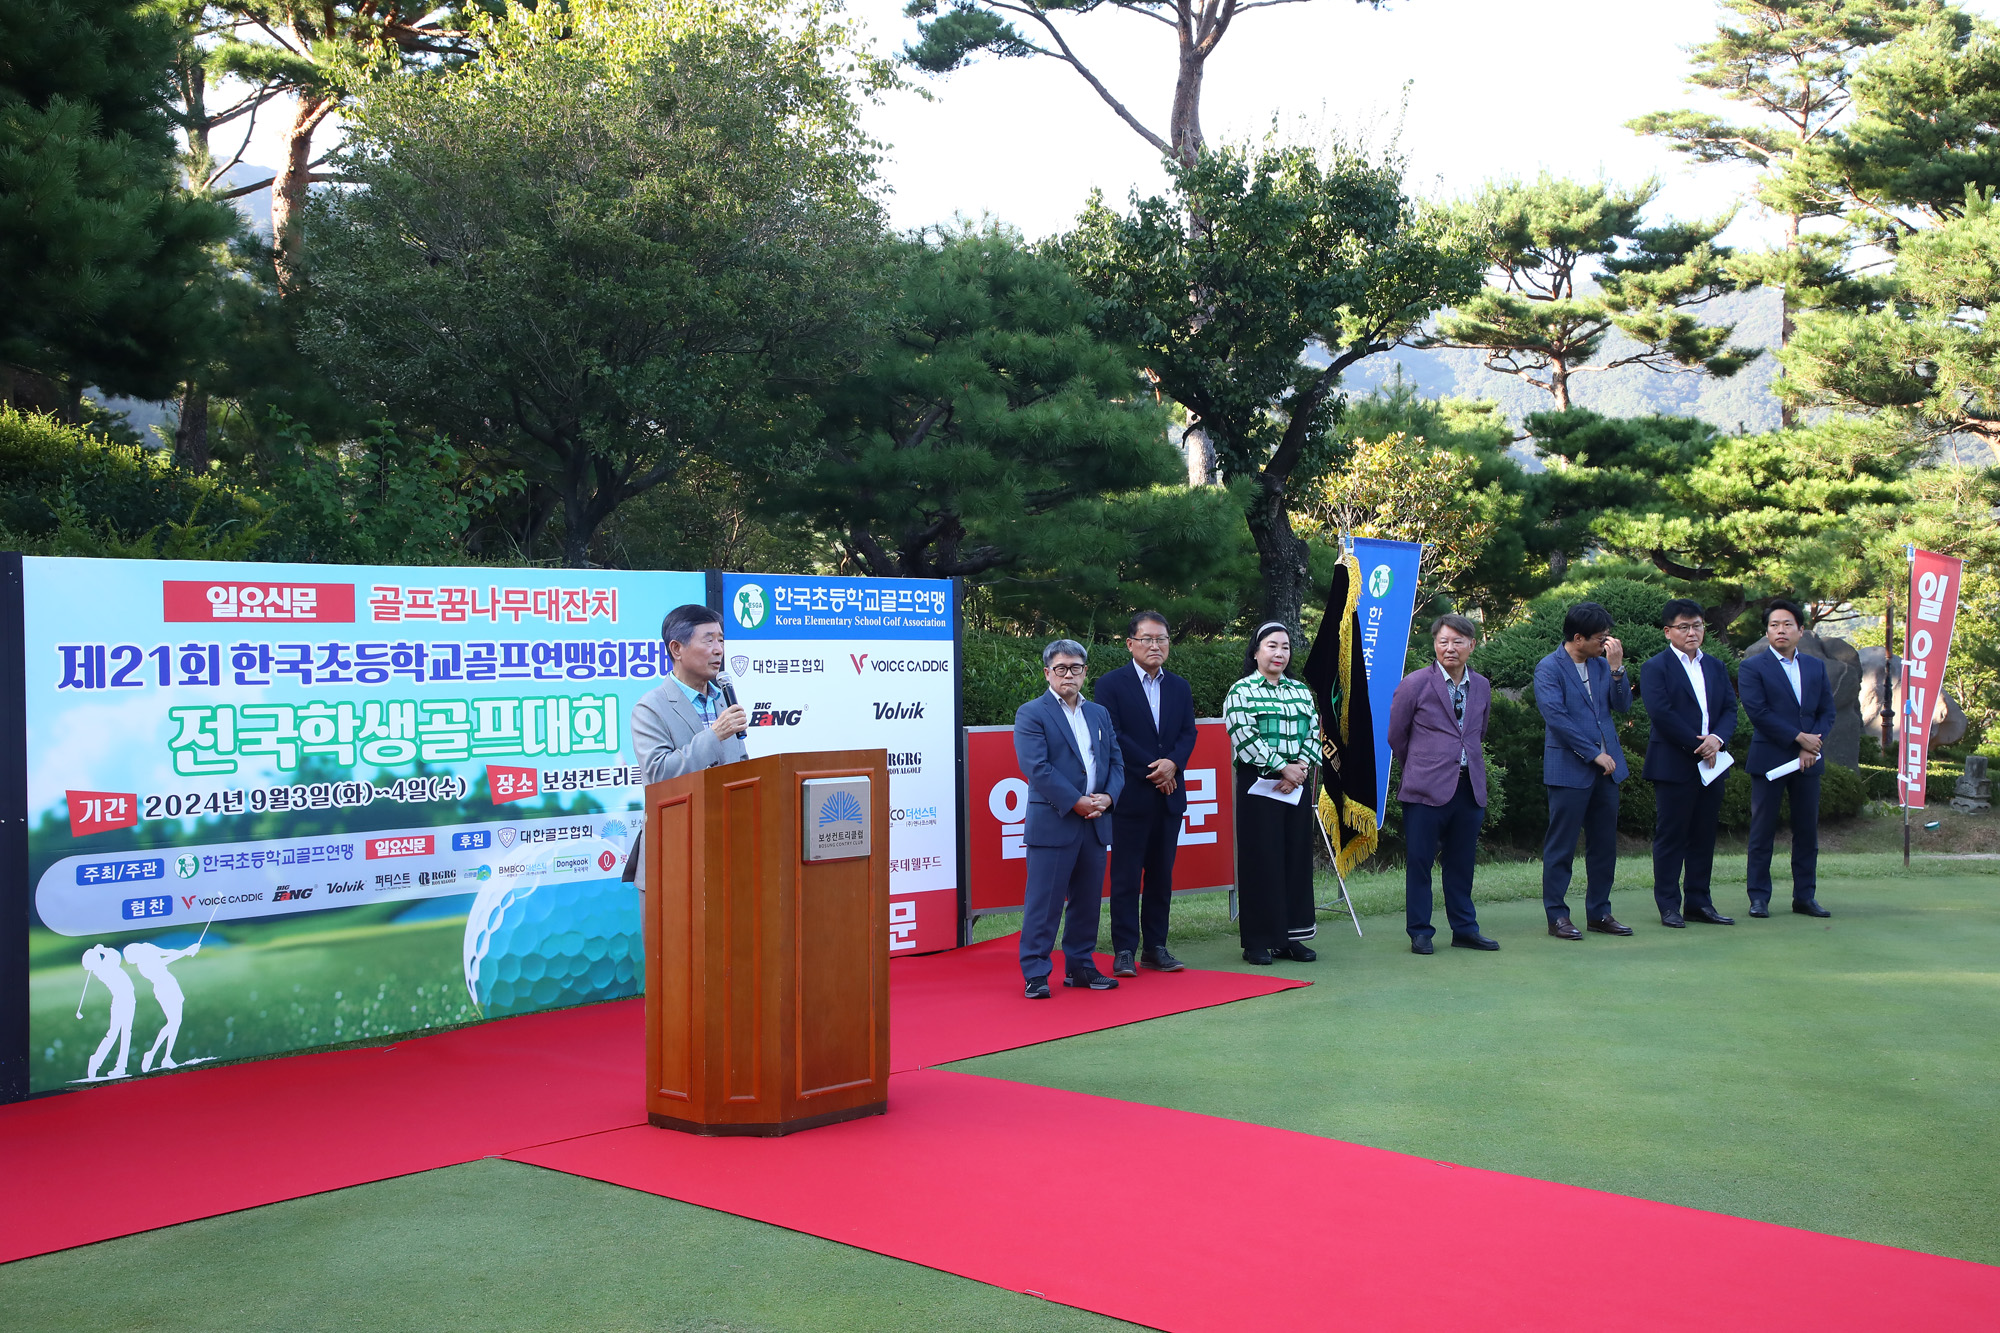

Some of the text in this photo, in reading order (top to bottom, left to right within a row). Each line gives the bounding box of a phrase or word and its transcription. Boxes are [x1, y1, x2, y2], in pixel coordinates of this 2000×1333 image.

[206, 586, 317, 618] 일요신문
[369, 585, 618, 622] 골프꿈나무대잔치
[774, 586, 945, 614] 한국초등학교골프연맹
[775, 614, 946, 628] Korea Elementary School Golf Association
[1362, 606, 1383, 680] 한국초
[57, 643, 220, 689] 제21회
[753, 659, 824, 674] 대한골프협회
[870, 660, 949, 672] VOICE CADDIE
[1905, 571, 1949, 791] 일요신문
[753, 702, 772, 710] BIG
[872, 701, 925, 720] Volvik
[169, 694, 620, 778] 전국학생골프대회
[79, 798, 128, 823] 기간
[145, 790, 244, 818] 2024년
[496, 773, 534, 795] 장소
[906, 806, 937, 820] 더선스틱
[460, 832, 484, 849] 후원
[520, 825, 593, 843] 대한골프협회
[818, 830, 864, 842] 보성컨트리클럽
[374, 837, 426, 857] 일요신문
[202, 843, 354, 873] 한국초등학교골프연맹
[556, 858, 589, 868] Dongkook
[83, 862, 158, 882] 주최/주관
[432, 869, 457, 881] RGRG
[498, 864, 526, 874] BMBCO
[326, 880, 365, 894] Volvik
[375, 872, 411, 887] 퍼티스트
[198, 892, 264, 907] VOICE CADDIE
